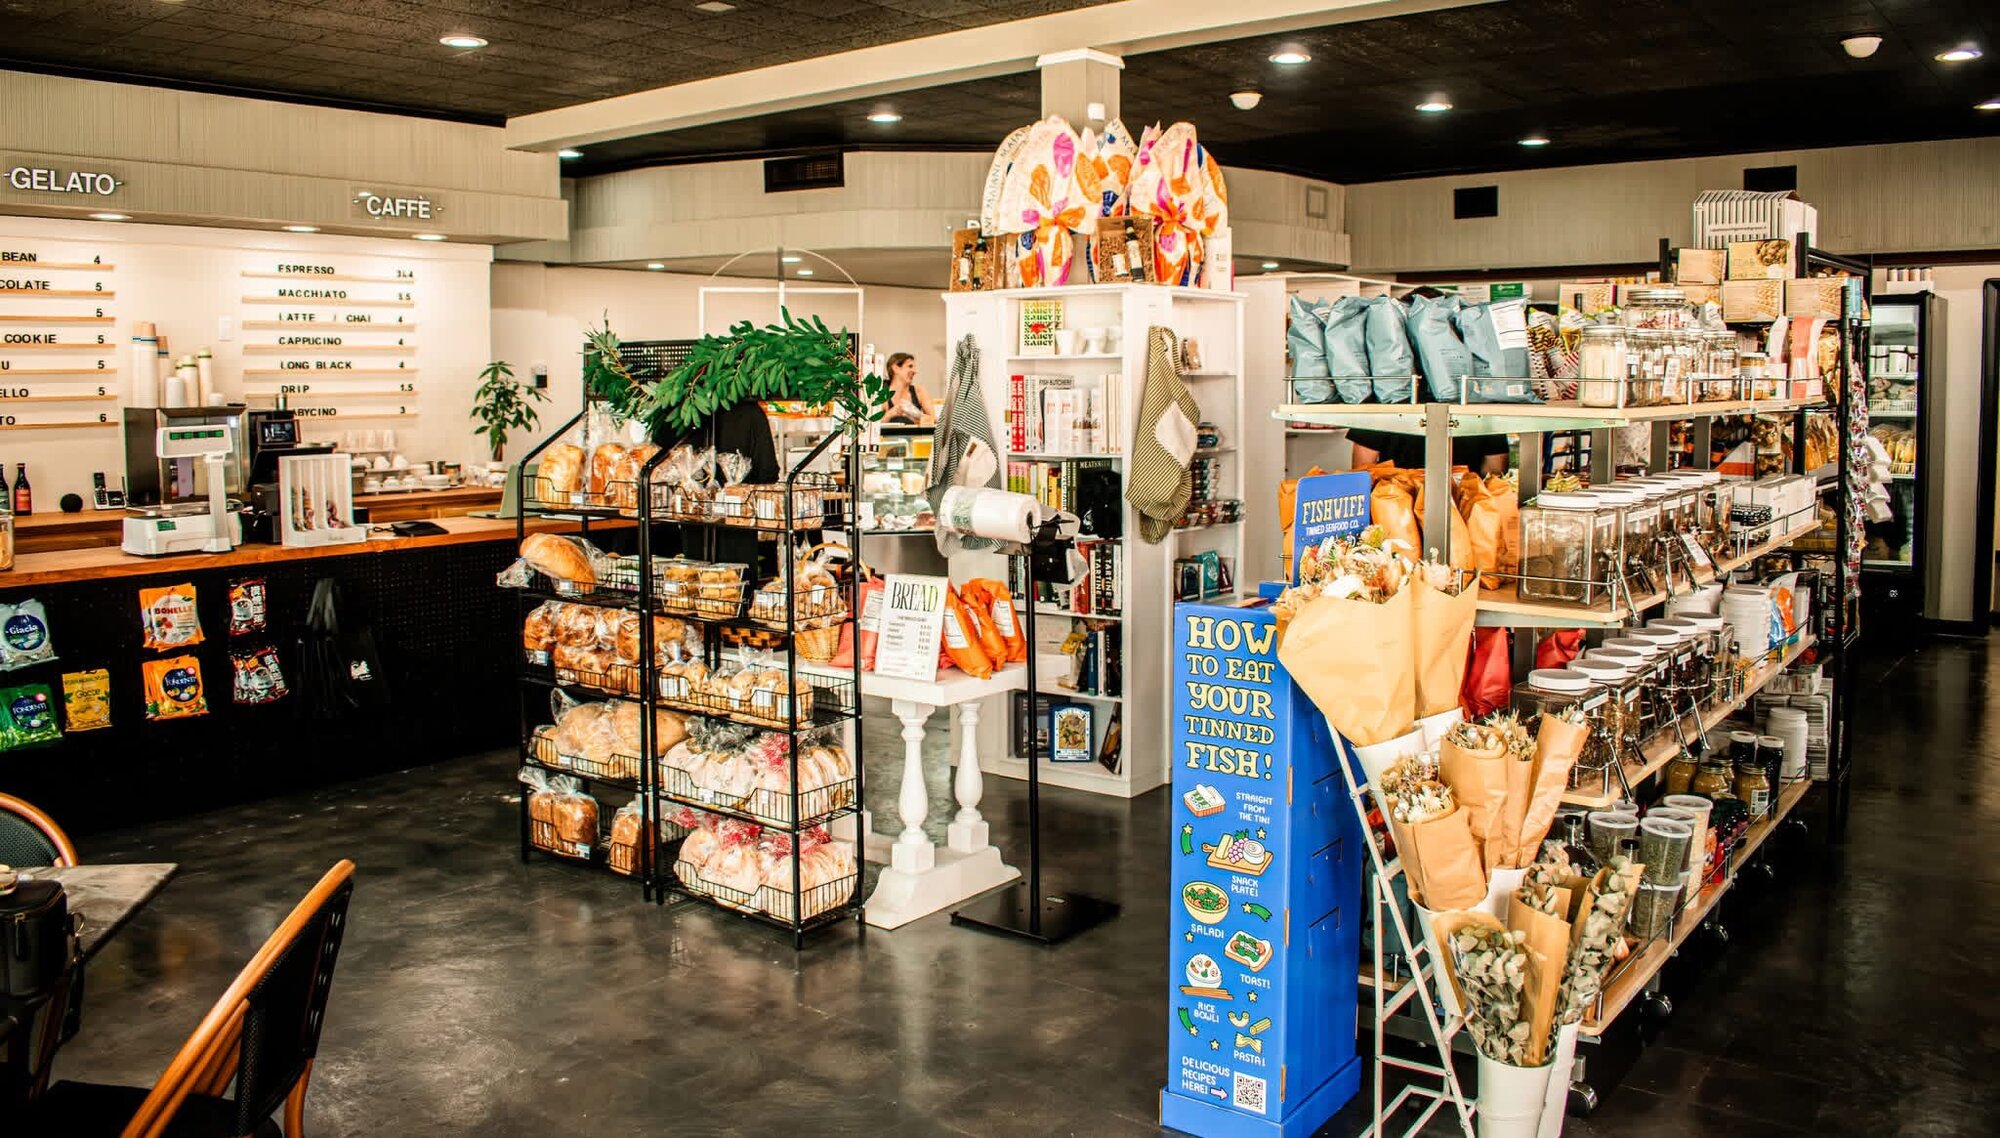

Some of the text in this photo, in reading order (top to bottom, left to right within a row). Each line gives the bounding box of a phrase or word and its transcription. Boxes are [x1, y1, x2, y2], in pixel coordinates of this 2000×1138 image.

[10, 166, 116, 196] GELATO
[366, 195, 431, 219] CAFFÈ
[2, 251, 101, 265] BEAN 4
[278, 264, 335, 275] ESPRESSO
[95, 282, 103, 292] 5
[278, 289, 347, 299] MACCHIATO
[96, 308, 103, 318] 5
[278, 313, 316, 322] LATTE
[346, 314, 372, 323] CHAI
[398, 315, 403, 323] 4
[4, 334, 105, 345] COOKIE 5
[278, 336, 404, 346] CAPPUCINO 4
[97, 360, 105, 370] 5
[280, 361, 404, 370] LONG BLACK 4
[0, 386, 106, 398] LLO 5
[281, 384, 414, 394] DRIP 1.5
[400, 406, 406, 414] 3
[99, 413, 107, 423] 6
[1302, 495, 1366, 524] FISHWIFE
[1306, 525, 1325, 536] TINNED
[1325, 521, 1349, 533] SEAFOOD
[1104, 559, 1112, 597] TARTINE
[891, 581, 939, 613] BREAD
[1185, 616, 1277, 656] HOW
[1186, 653, 1276, 684] TO EAT
[1185, 682, 1275, 720] YOUR
[1184, 715, 1275, 746] TINNED
[1185, 742, 1273, 781] FISH!
[1235, 791, 1273, 806] STRAIGHT
[1243, 803, 1266, 814] FROM
[1239, 811, 1271, 825] THE TIN!
[1231, 875, 1259, 888] SNACK
[1231, 885, 1259, 898] PLATE!
[1190, 923, 1225, 939] SALAD!
[1239, 973, 1271, 990] TOAST!
[1197, 1001, 1216, 1014] RICE
[1193, 1010, 1220, 1024] BOWL!
[1233, 1050, 1266, 1067] PASTA!
[1181, 1056, 1231, 1078] DELICIOUS
[1181, 1068, 1217, 1086] RECIPES
[1181, 1078, 1209, 1095] HERE!
